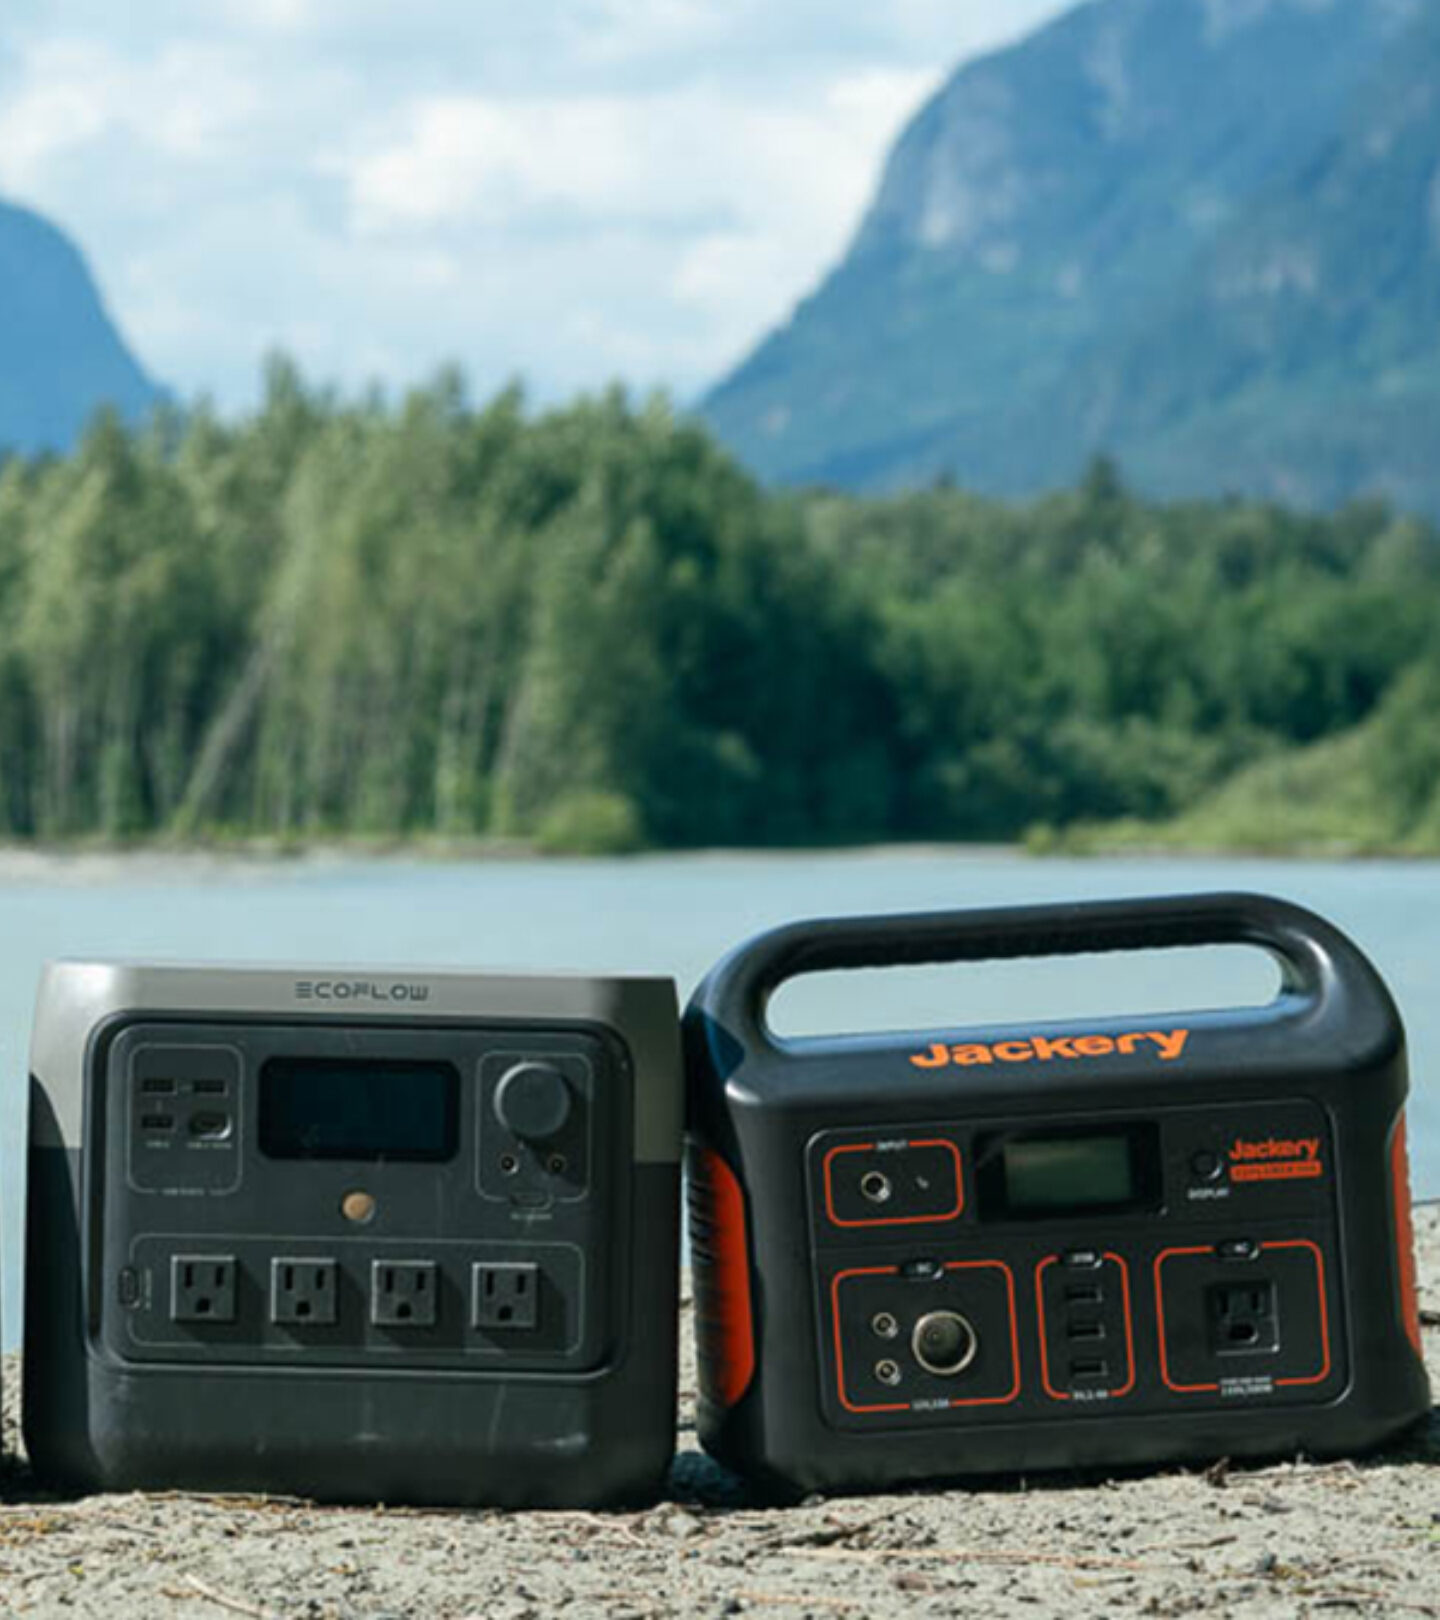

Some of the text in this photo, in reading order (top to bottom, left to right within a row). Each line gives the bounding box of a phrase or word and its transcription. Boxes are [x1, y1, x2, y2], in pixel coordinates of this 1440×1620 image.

[295, 981, 429, 1001] ECOFLOW
[909, 1028, 1189, 1068] Jackery
[1228, 1137, 1319, 1160] Jackery
